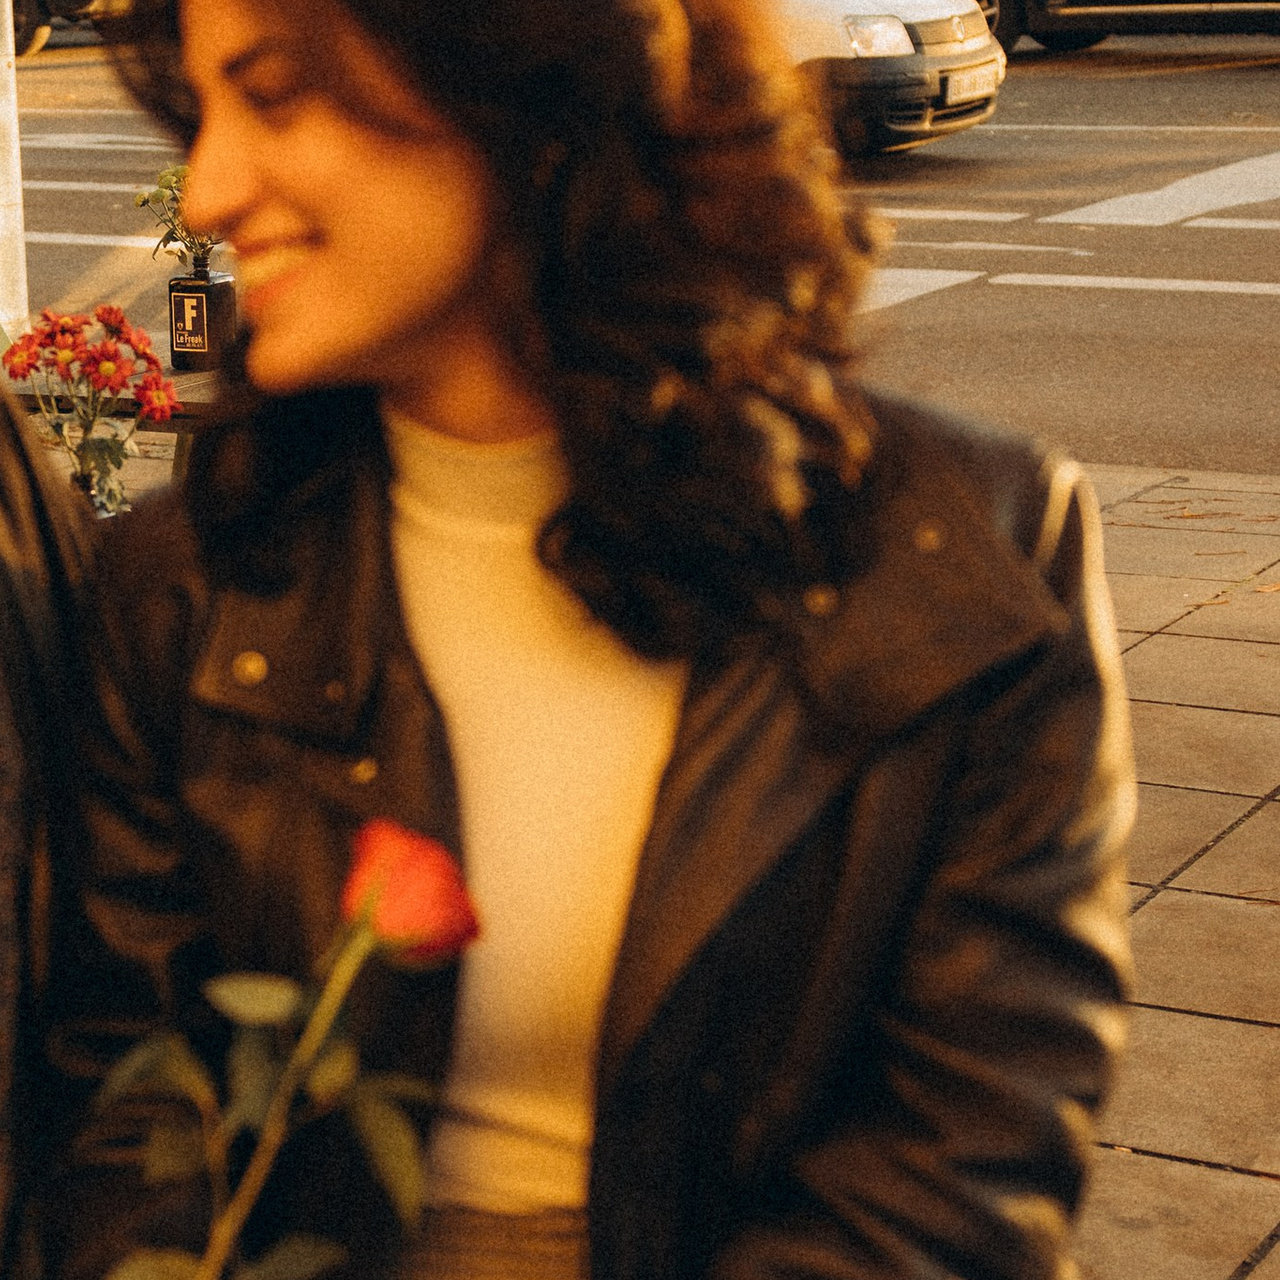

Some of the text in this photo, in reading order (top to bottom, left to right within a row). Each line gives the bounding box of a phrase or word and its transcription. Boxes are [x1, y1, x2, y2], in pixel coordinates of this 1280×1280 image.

[184, 298, 197, 330] F
[176, 333, 203, 344] Le Freak
